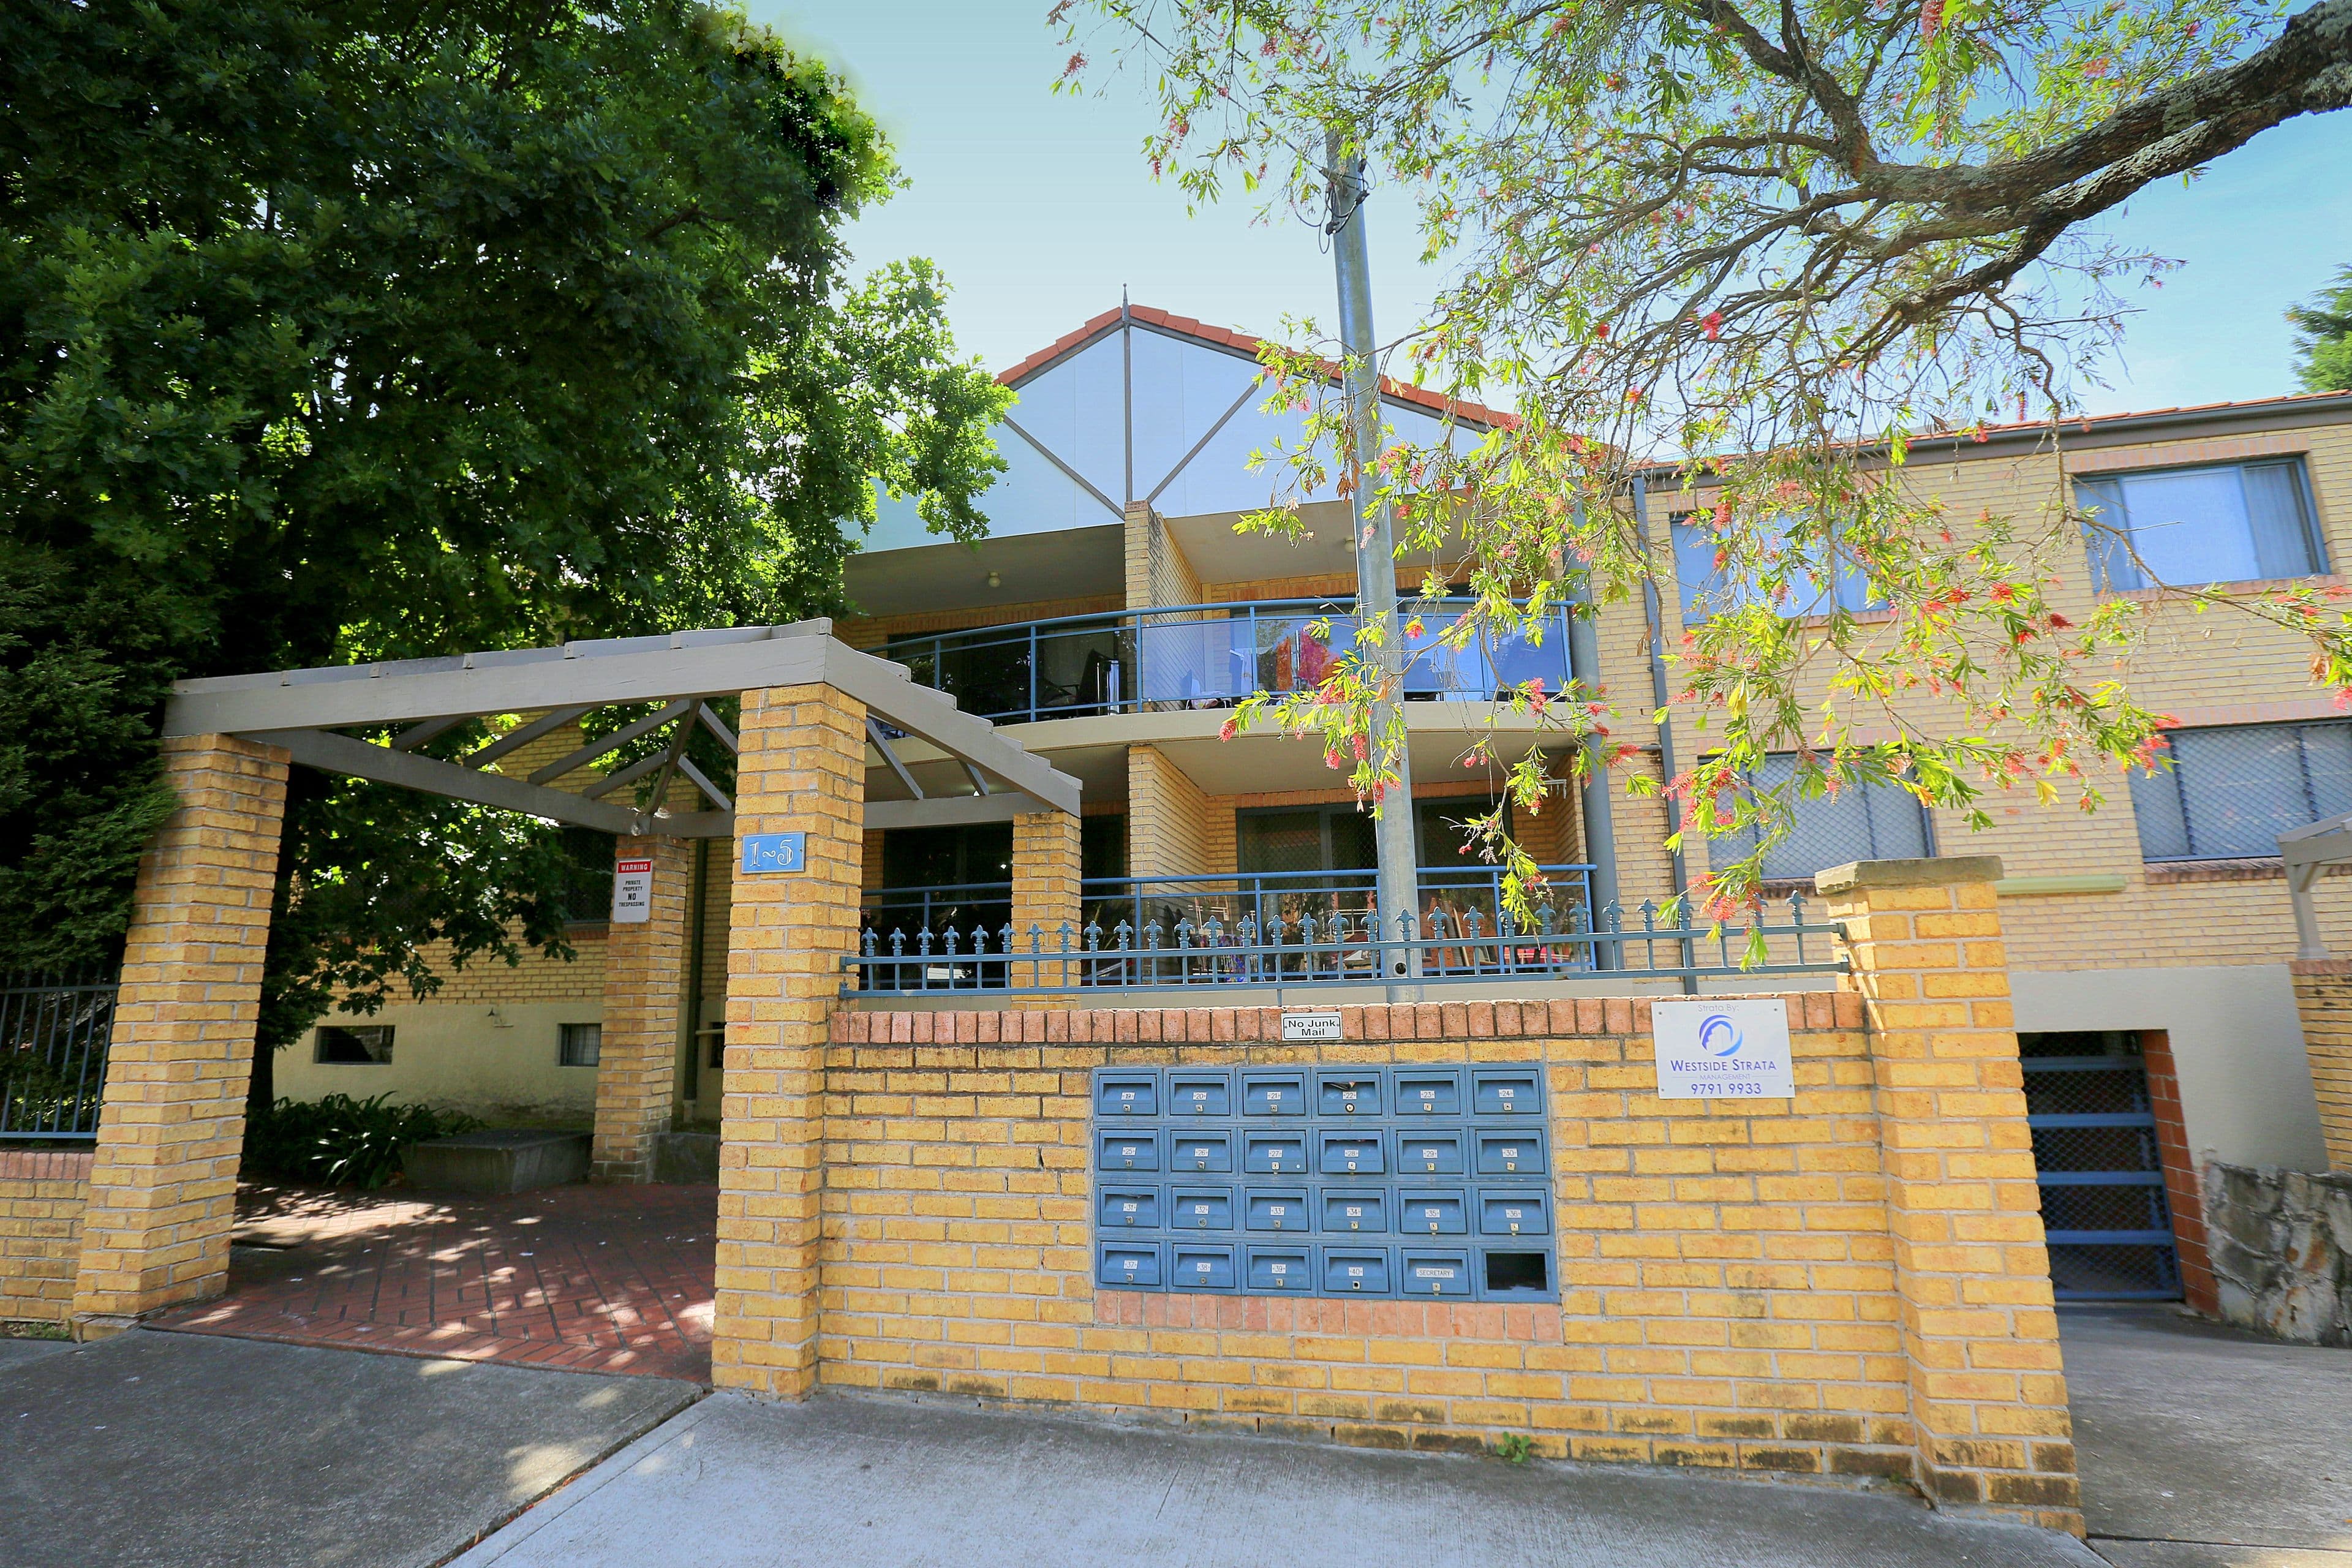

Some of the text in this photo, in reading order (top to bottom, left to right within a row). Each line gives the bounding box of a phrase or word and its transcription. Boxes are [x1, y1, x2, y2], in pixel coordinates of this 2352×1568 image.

[1727, 1004, 1739, 1012] By:
[1691, 1083, 1762, 1095] 9791 9933
